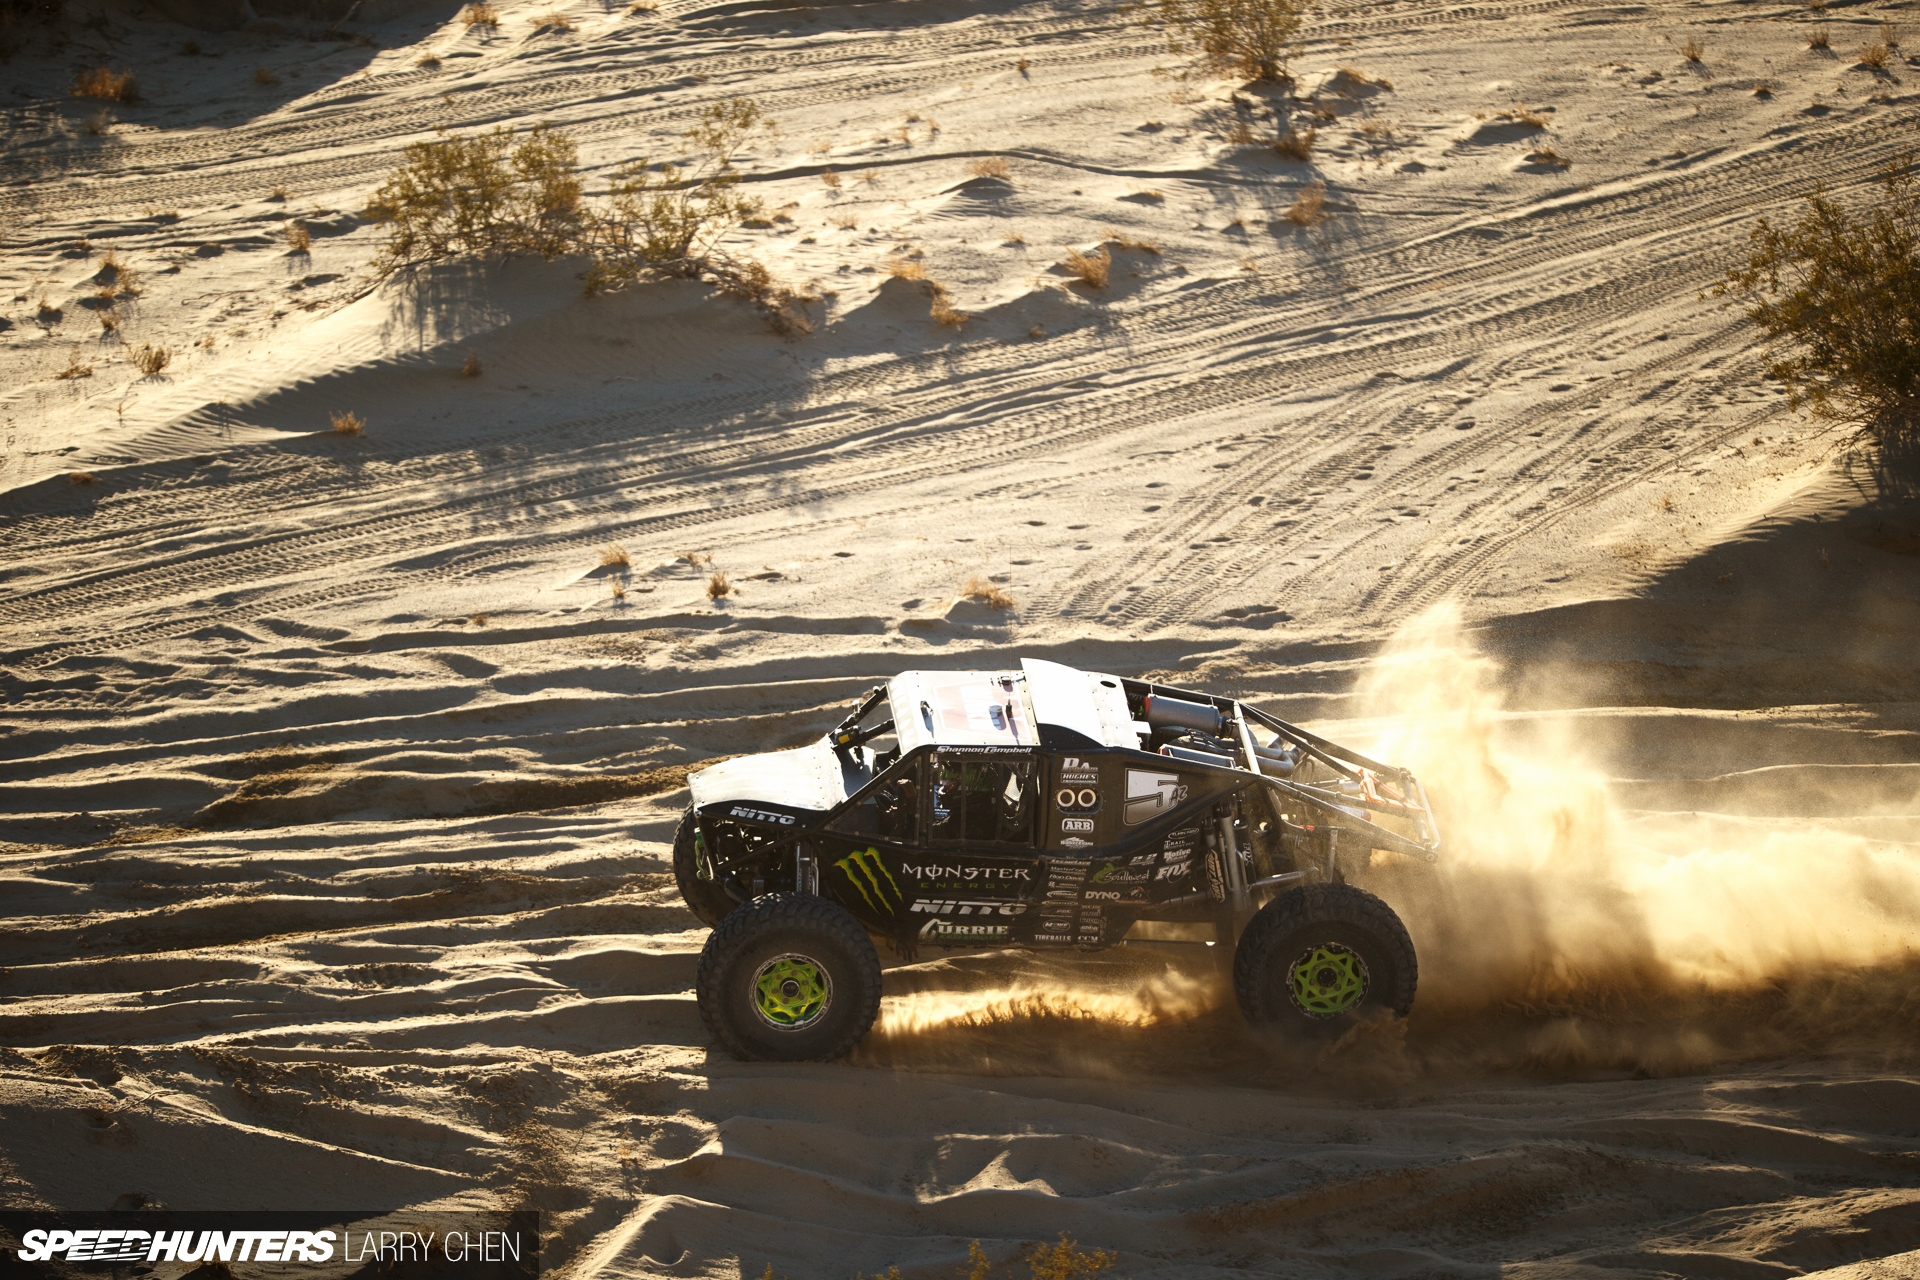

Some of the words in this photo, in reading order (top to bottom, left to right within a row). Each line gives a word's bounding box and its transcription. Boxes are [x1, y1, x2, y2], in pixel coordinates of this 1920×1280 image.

[937, 745, 984, 753] Shannon
[984, 746, 1033, 754] Campbell
[729, 806, 796, 825] NITTO
[1065, 821, 1091, 831] ARB
[902, 863, 1032, 881] MONSTER
[1155, 859, 1194, 882] FOX
[910, 899, 1028, 915] NITTO
[918, 918, 1009, 940] CURRIE
